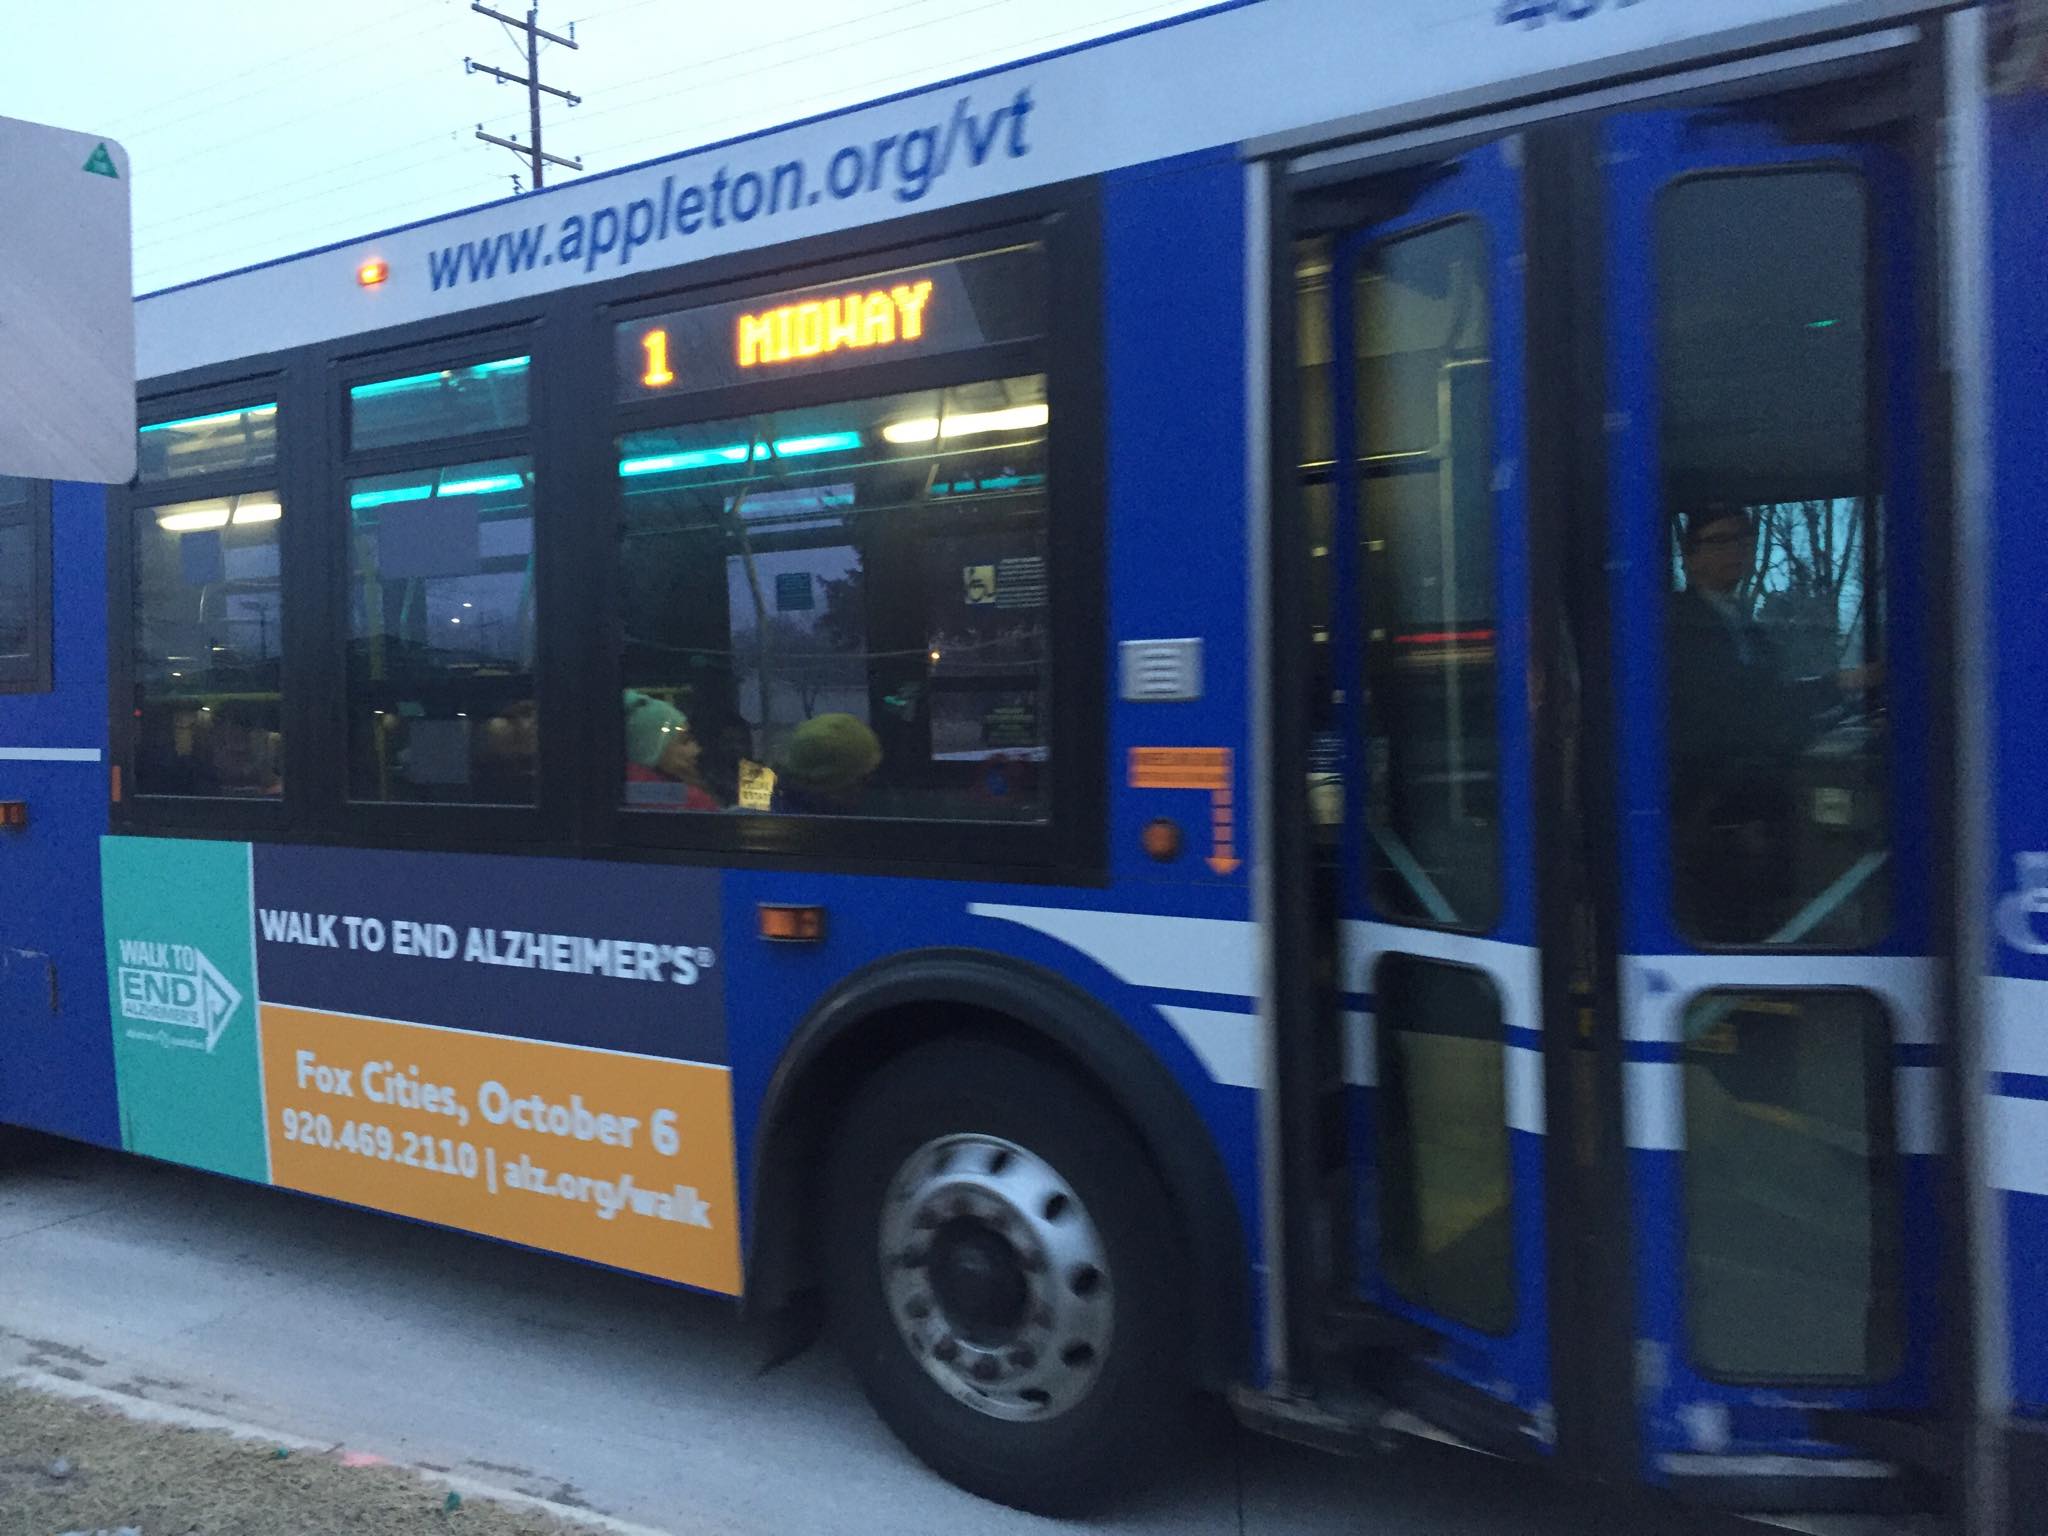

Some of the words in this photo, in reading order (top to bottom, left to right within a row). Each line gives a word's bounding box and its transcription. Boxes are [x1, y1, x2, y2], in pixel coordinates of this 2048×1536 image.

[427, 84, 1034, 291] www.appleton.org/vt
[641, 330, 674, 387] 1
[736, 280, 934, 368] MIDWAY
[119, 939, 170, 969] WALK
[171, 944, 195, 972] TO
[259, 908, 340, 948] WALK
[342, 916, 386, 952] TO
[392, 920, 458, 959] END
[123, 971, 198, 1007] END
[296, 1050, 353, 1097] Fox
[361, 1060, 469, 1126] Cities,
[478, 1080, 641, 1148] October
[652, 1108, 680, 1157] 6
[282, 1107, 478, 1178] 920.469.2110
[504, 1152, 713, 1229] alz.org/walk
